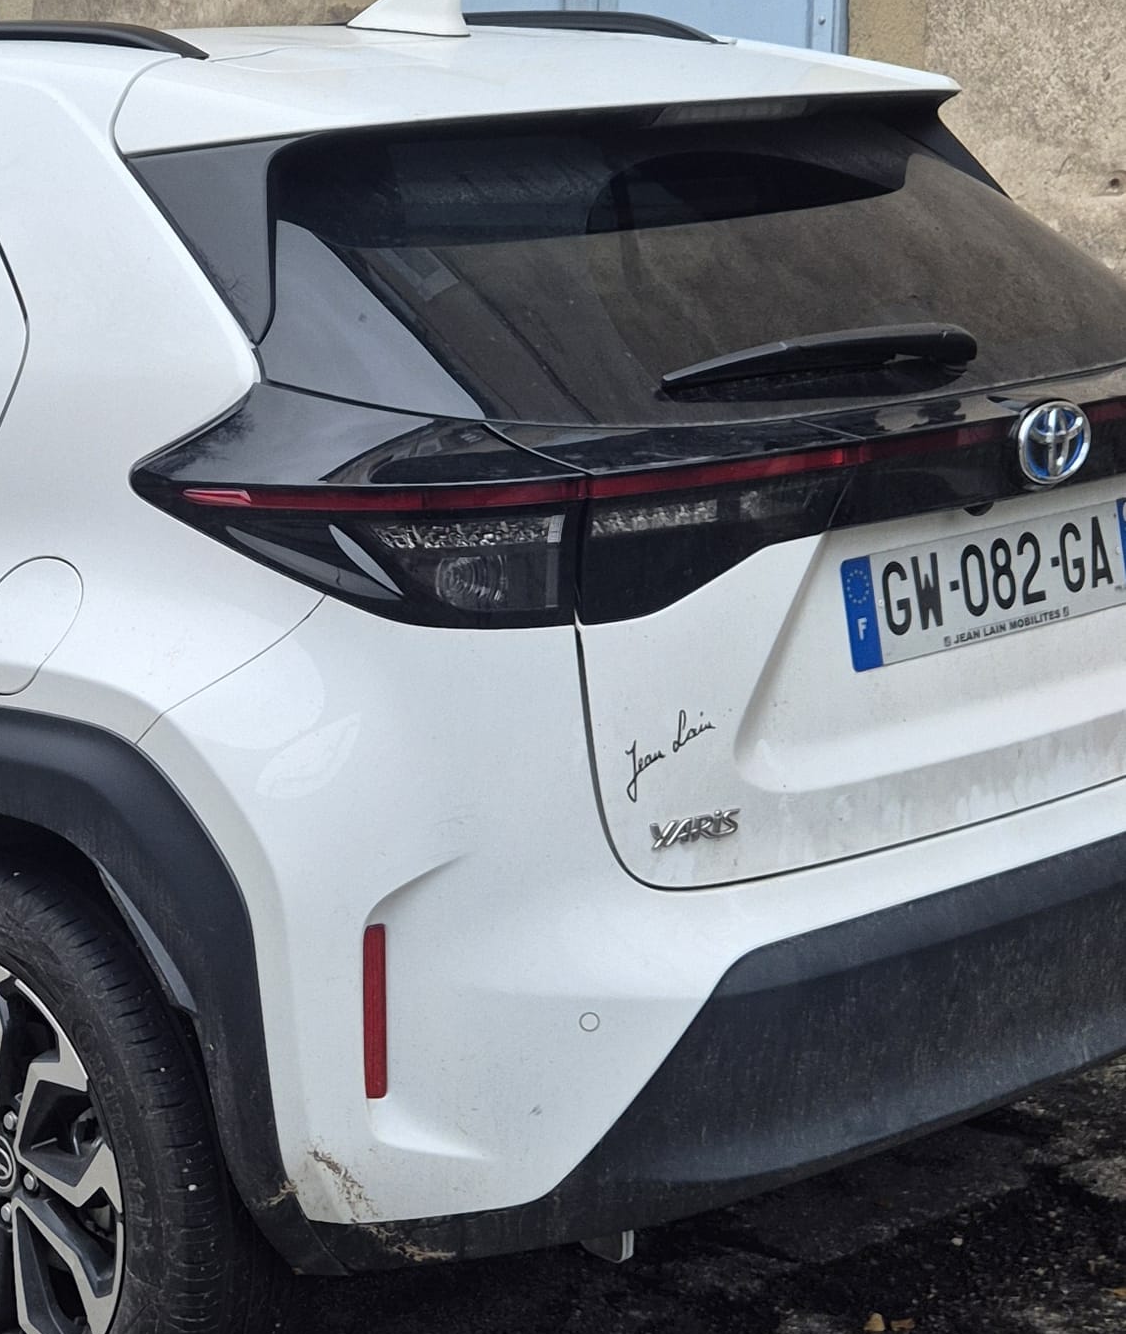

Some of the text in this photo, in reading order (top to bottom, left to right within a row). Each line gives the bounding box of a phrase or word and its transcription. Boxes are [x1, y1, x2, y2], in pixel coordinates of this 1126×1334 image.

[882, 516, 1114, 636] GW-082-GA
[857, 617, 868, 641] F
[953, 610, 1061, 645] JEAN LAIN MOBILITES
[625, 709, 716, 803] Jean Lain
